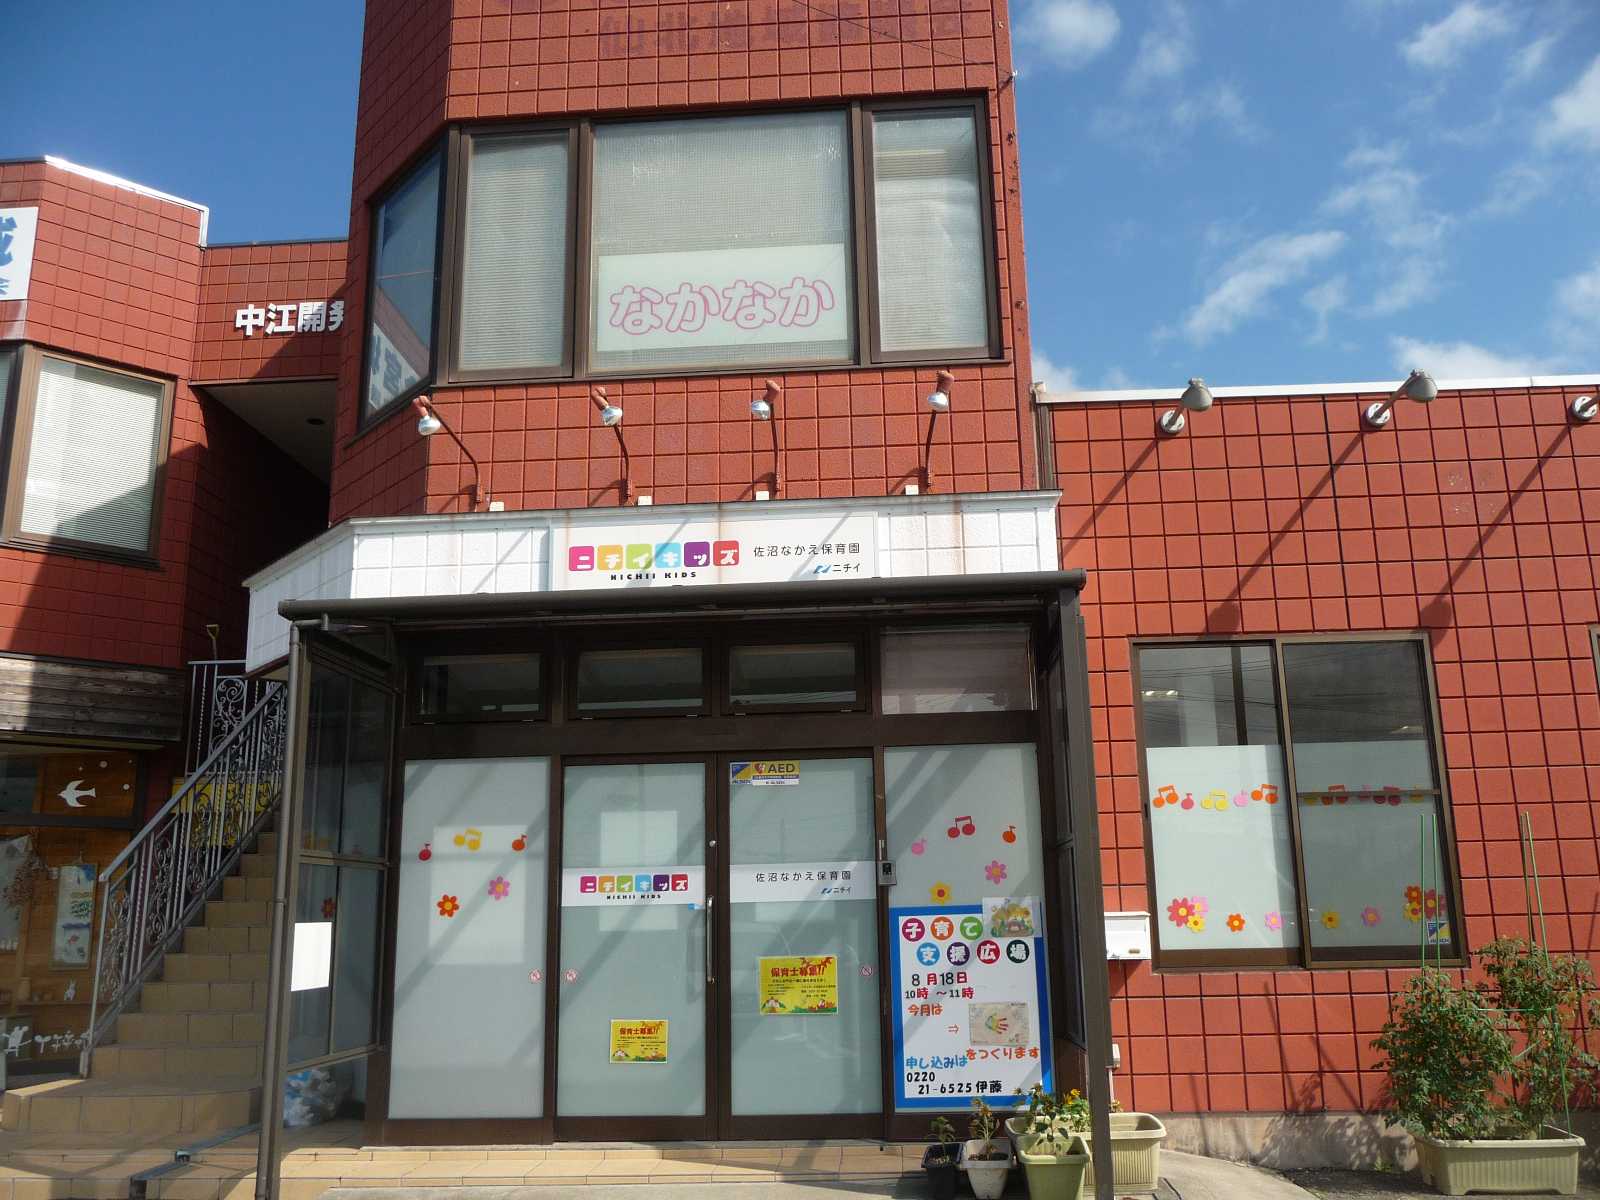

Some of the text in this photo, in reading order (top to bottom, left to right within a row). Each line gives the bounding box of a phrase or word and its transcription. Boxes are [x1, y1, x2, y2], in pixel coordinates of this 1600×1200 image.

[609, 276, 835, 336] なかなか
[753, 542, 860, 557] 佐沼なかえ保育園
[574, 546, 738, 570] ニチイキッズ
[664, 571, 697, 579] KIDS
[832, 563, 861, 573] ニチイ
[767, 763, 795, 773] AED
[755, 870, 852, 883] 佐沼なかえ保育園
[583, 877, 688, 892] ニチイキッズ
[904, 919, 980, 939] 子育て
[918, 942, 1027, 963] 支援広場
[907, 1002, 943, 1017] 今月は
[965, 1046, 1040, 1061] をつくります
[905, 1054, 968, 1069] 申し込みは
[906, 1071, 936, 1082] 0220
[975, 1080, 1003, 1094] 伊藤
